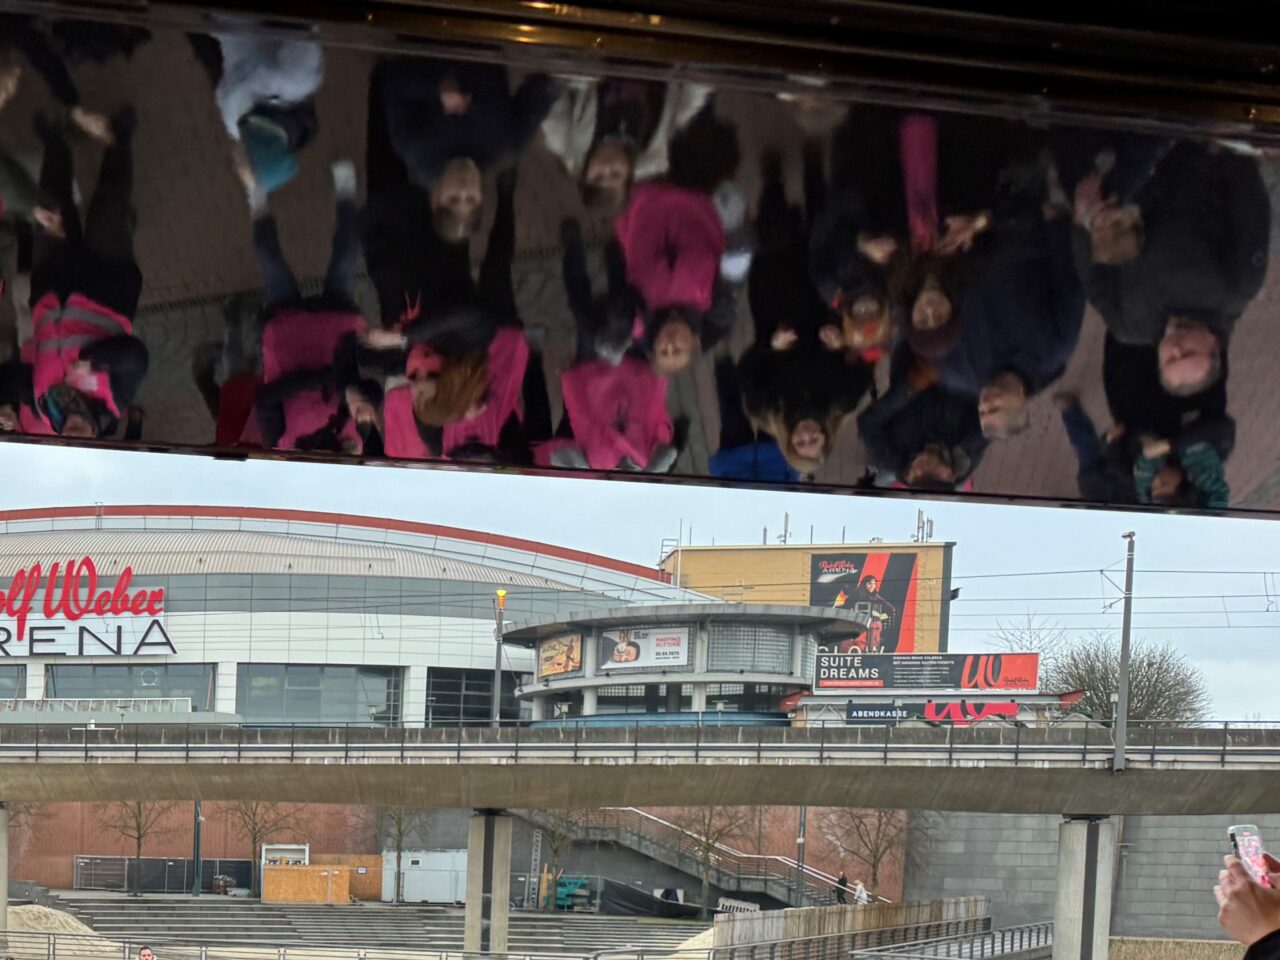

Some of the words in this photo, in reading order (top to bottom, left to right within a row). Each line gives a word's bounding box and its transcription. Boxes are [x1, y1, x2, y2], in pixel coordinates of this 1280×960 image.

[43, 556, 165, 621] Weber
[821, 657, 862, 666] SUITE
[820, 668, 879, 678] DREAMS
[852, 710, 908, 718] ABENDKASSE
